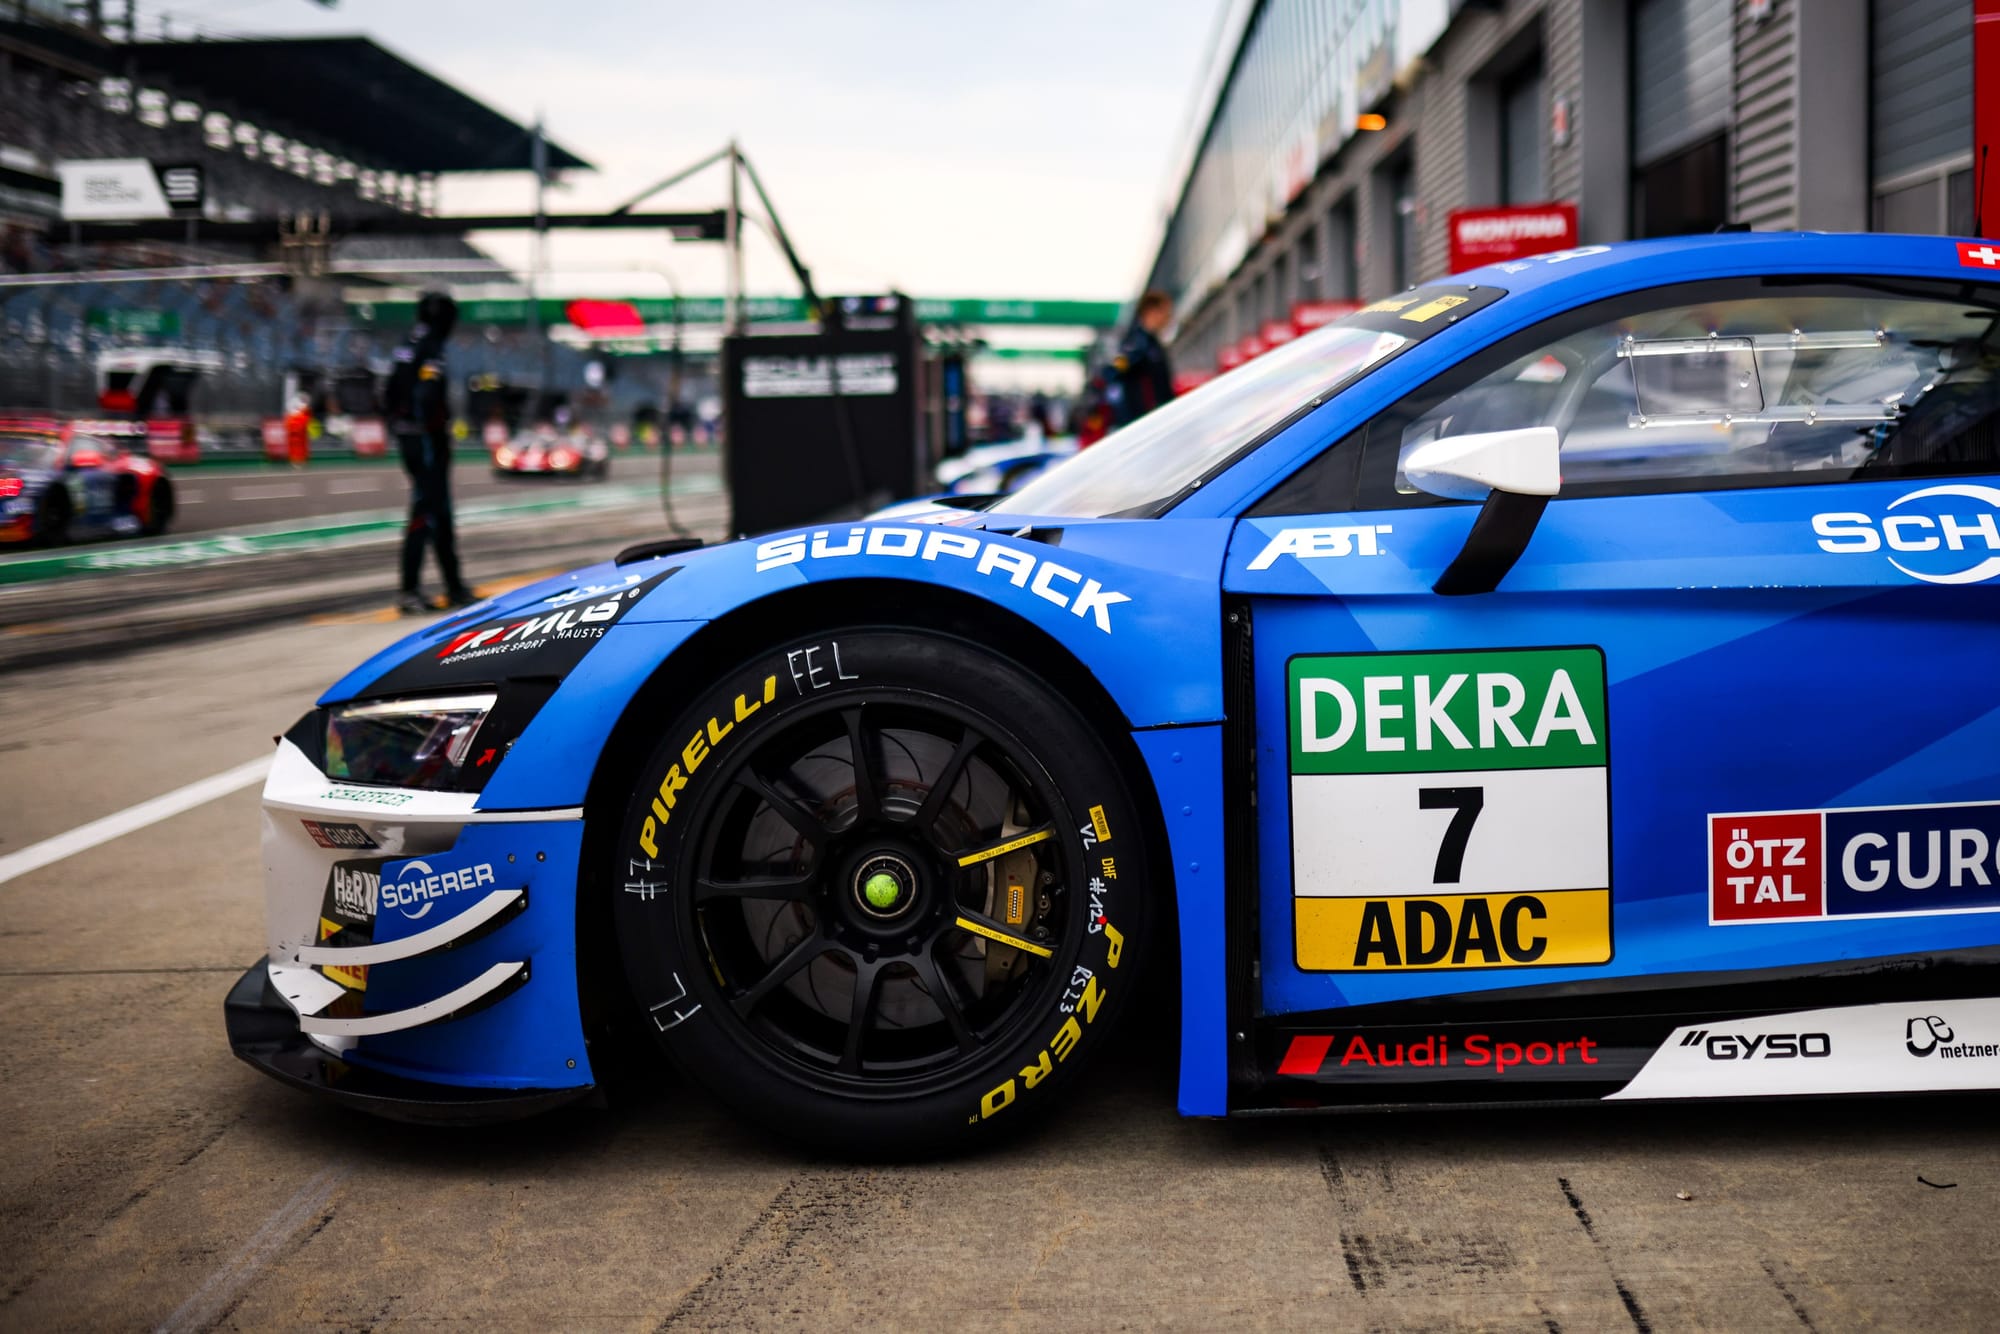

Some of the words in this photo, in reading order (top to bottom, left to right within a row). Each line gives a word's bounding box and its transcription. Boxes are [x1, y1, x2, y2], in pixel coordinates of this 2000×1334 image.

[1246, 524, 1393, 571] ABT
[755, 527, 1133, 635] SÜDPACK
[509, 637, 547, 653] SPORT
[552, 626, 605, 641] HAUSTS
[787, 641, 860, 696] FEL
[1299, 668, 1598, 753] DEKRA
[639, 674, 777, 859] PIRELLI
[1418, 786, 1484, 884] 7
[1726, 828, 1806, 869] ÖTZ
[1101, 857, 1118, 880] DHF
[1842, 827, 2000, 892] GUR
[381, 863, 495, 909] SCHERER
[1726, 874, 1806, 904] TAL
[1103, 922, 1124, 969] P
[1353, 895, 1548, 967] ADAC
[981, 975, 1106, 1119] ZERO
[1340, 1034, 1448, 1067] Audi
[1463, 1034, 1599, 1074] Sport
[1940, 1042, 2000, 1059] metzner
